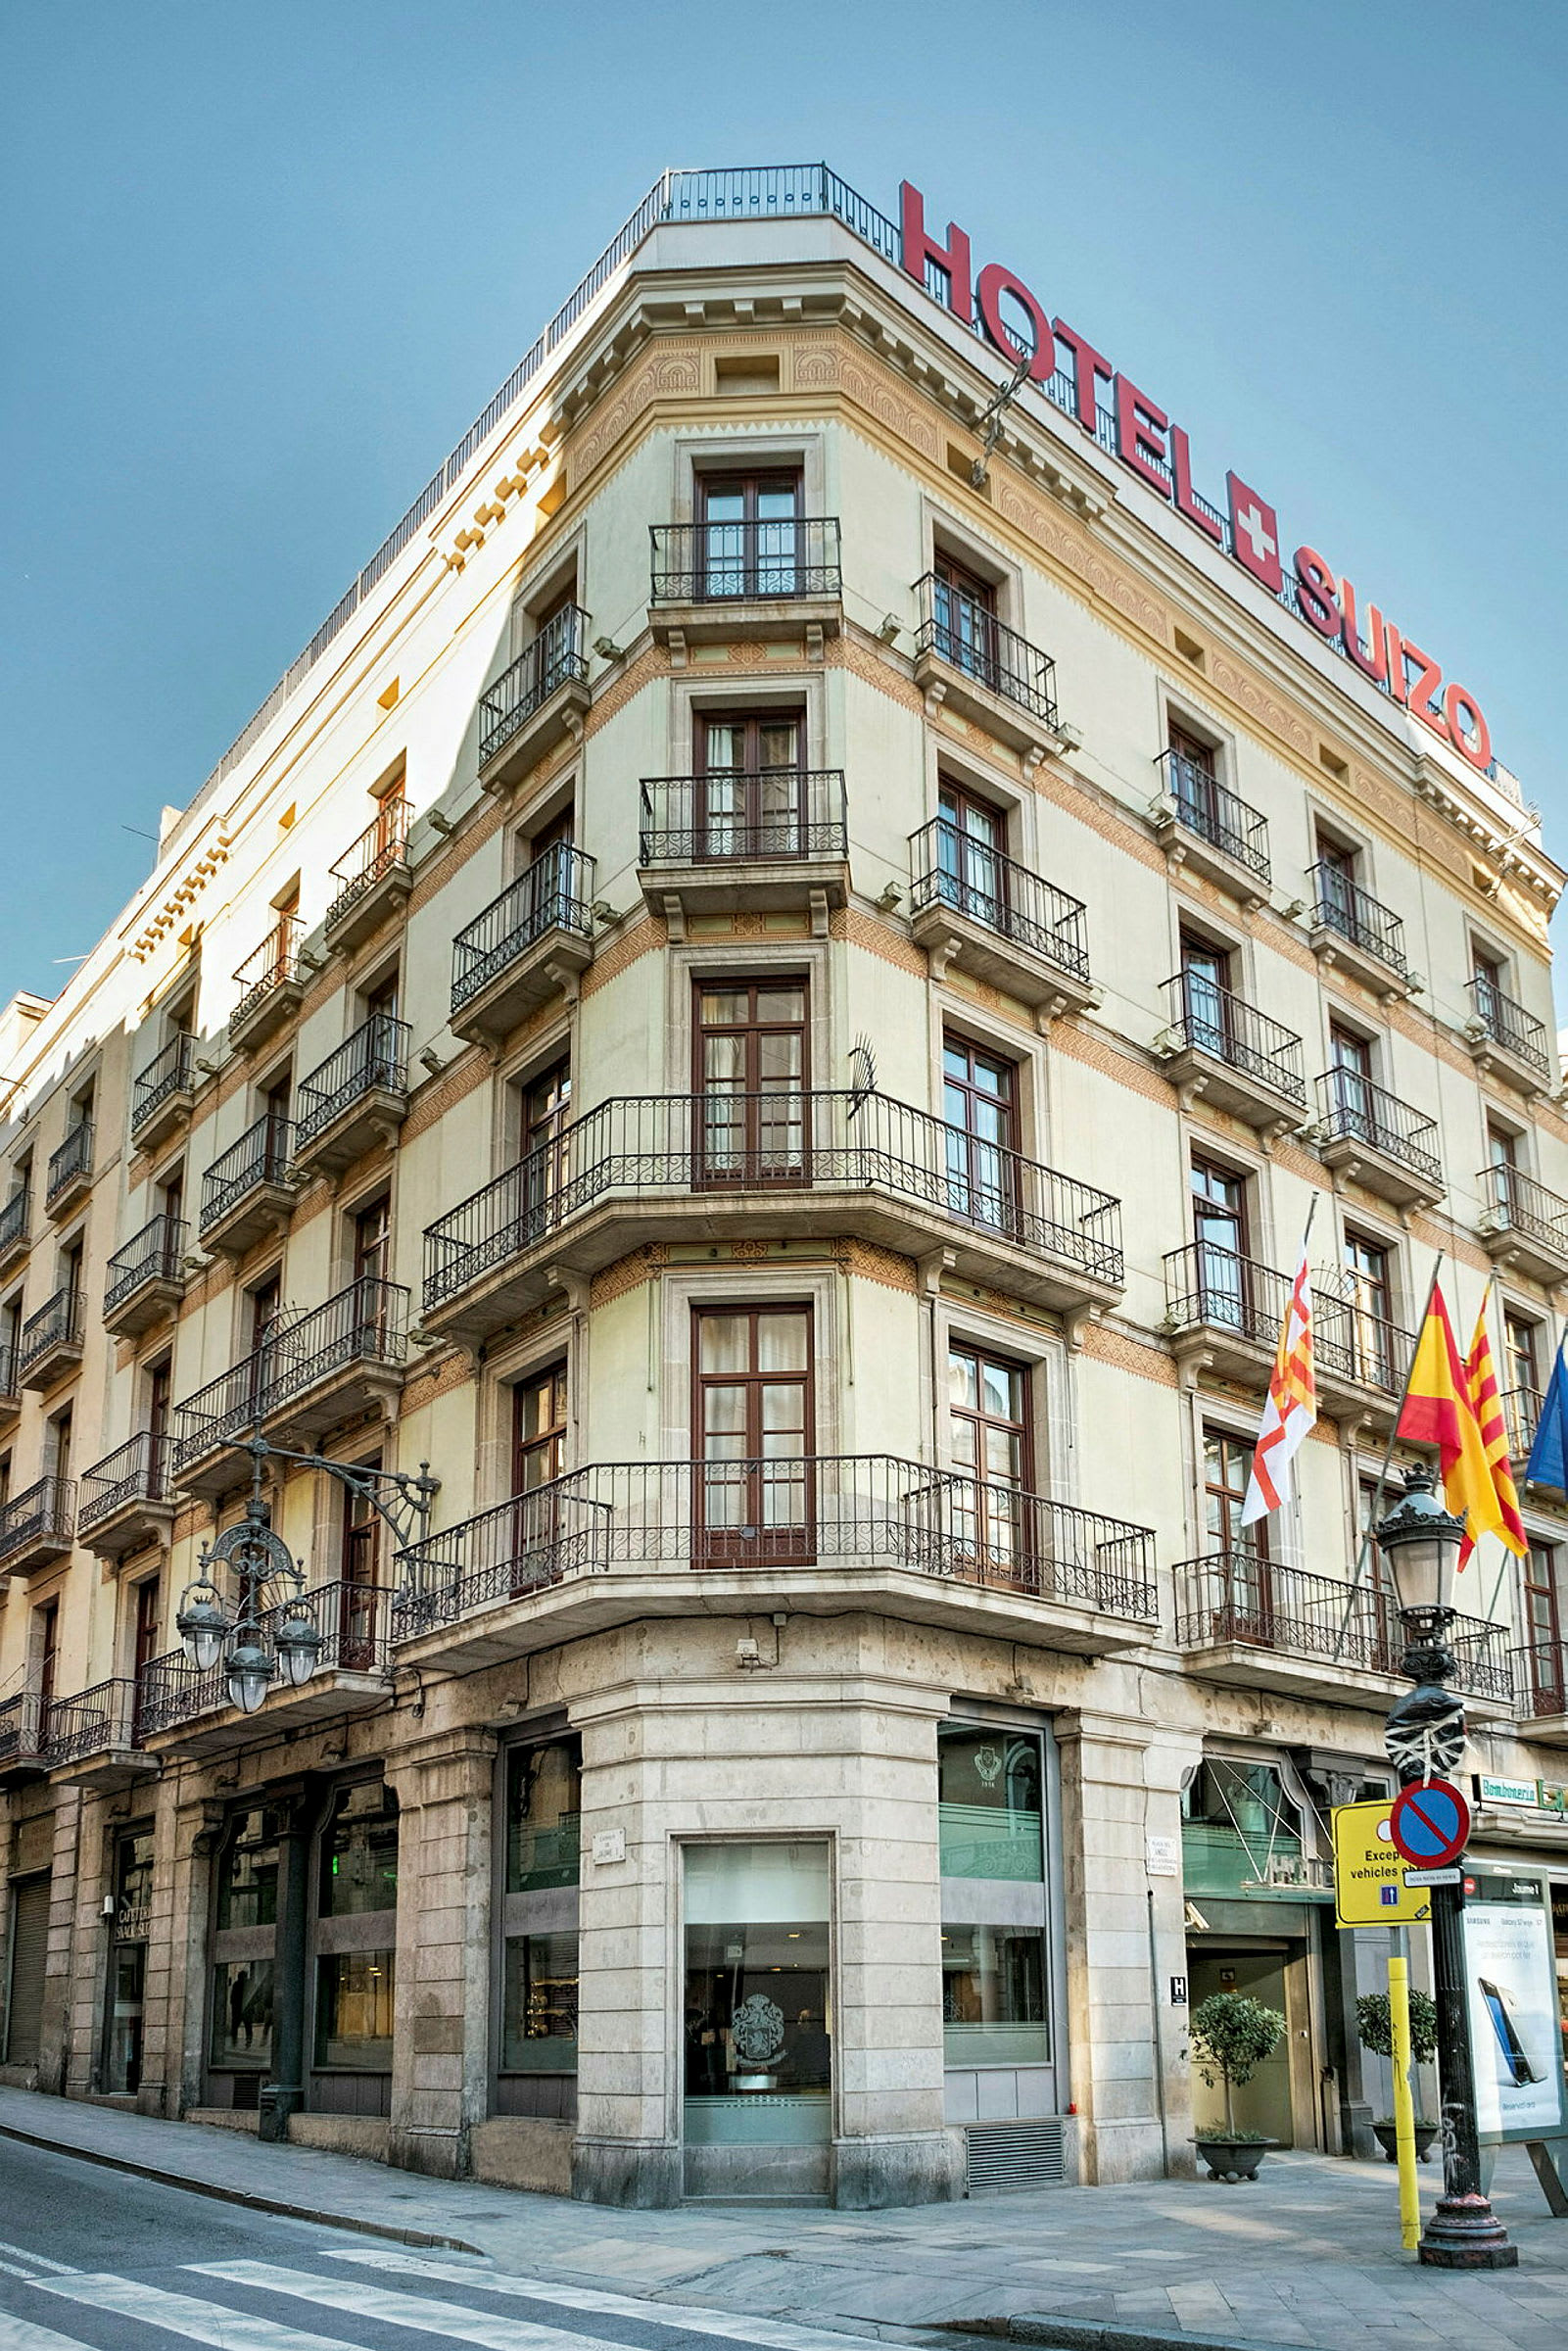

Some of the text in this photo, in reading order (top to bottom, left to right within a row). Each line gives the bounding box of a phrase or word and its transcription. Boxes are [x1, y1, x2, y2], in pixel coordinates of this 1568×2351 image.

[898, 179, 1493, 771] HOTEL SUIZO
[1365, 1849, 1400, 1862] Excep
[1351, 1865, 1398, 1879] vehicles
[1174, 1978, 1184, 1995] H
